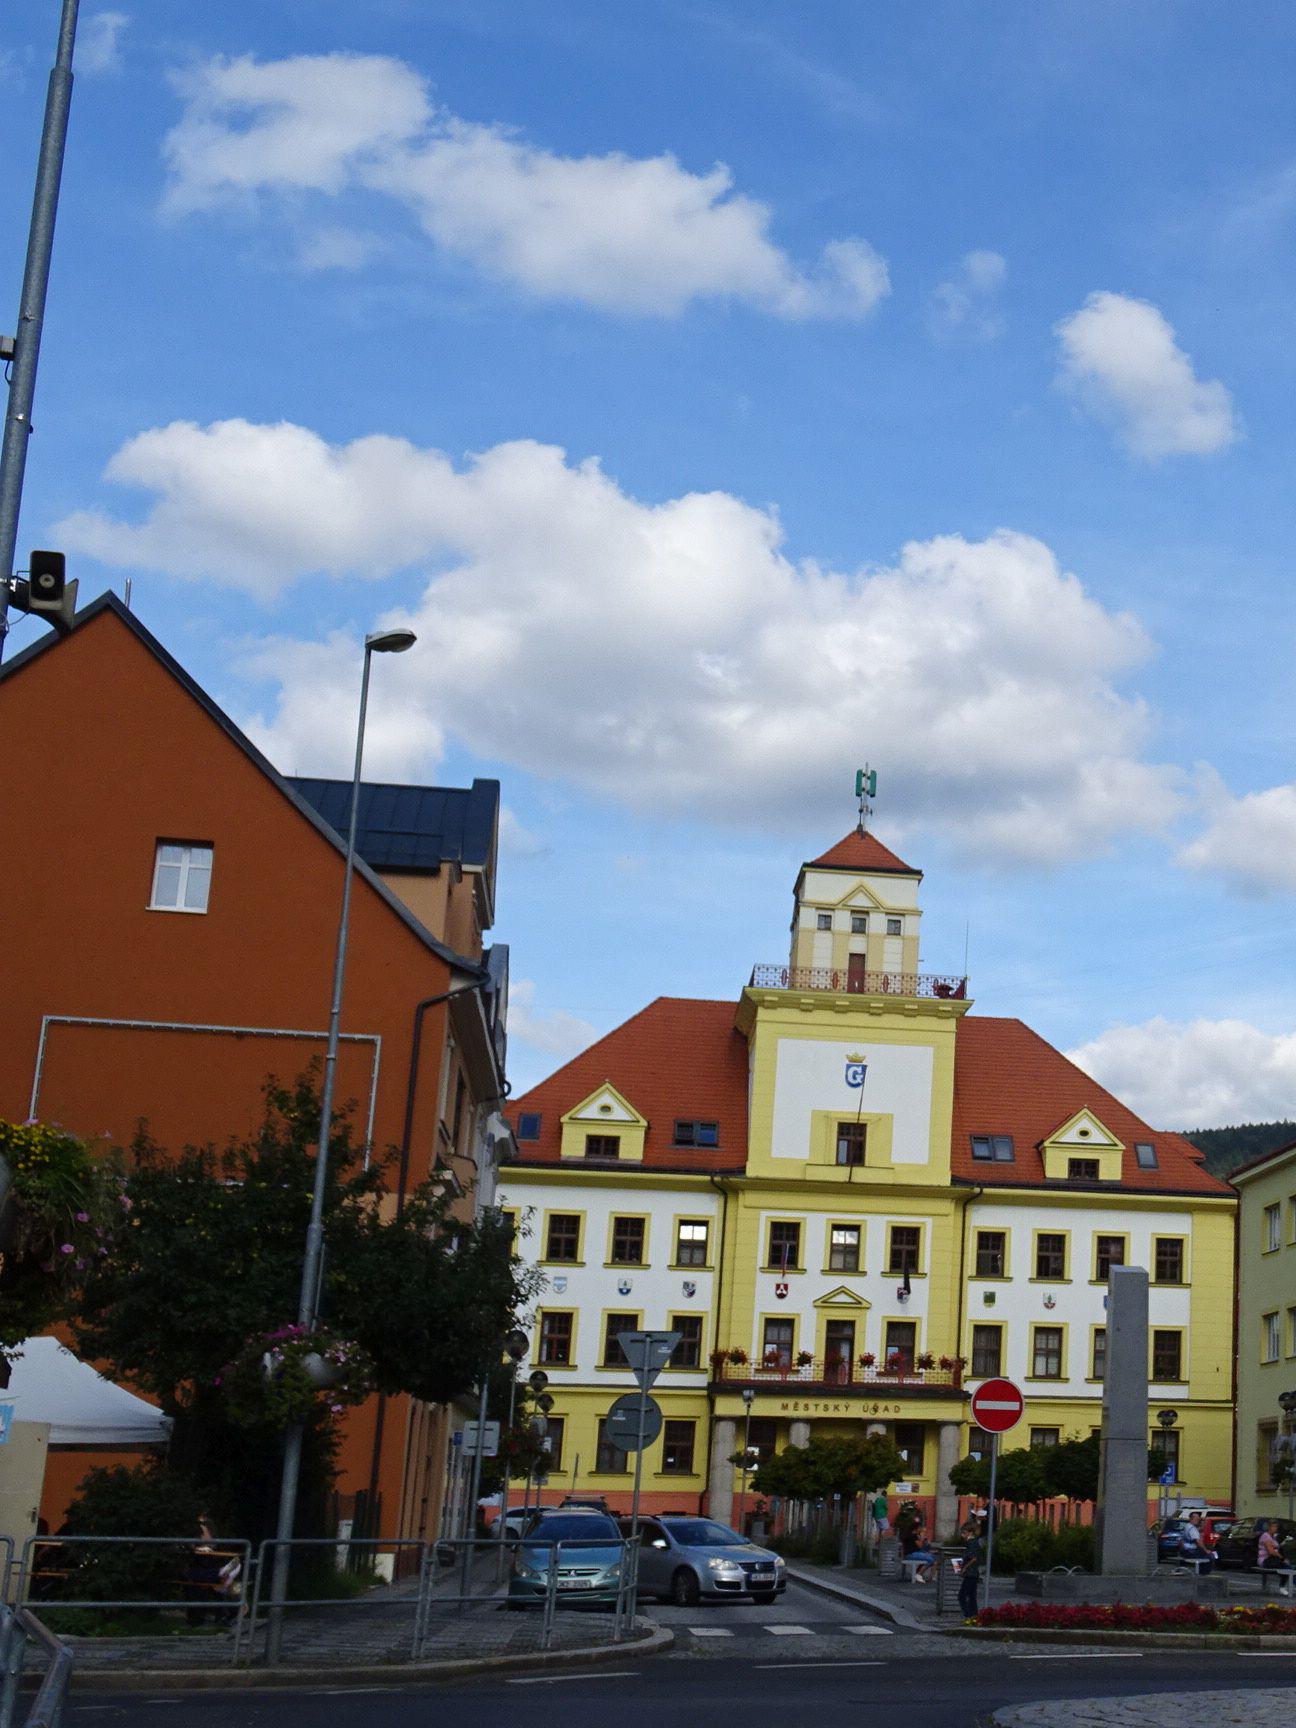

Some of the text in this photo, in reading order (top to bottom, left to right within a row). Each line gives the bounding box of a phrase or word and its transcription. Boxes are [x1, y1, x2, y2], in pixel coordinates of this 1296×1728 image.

[847, 1066, 864, 1084] G
[781, 1401, 901, 1414] MĚSTSKÝ ÚŘAD
